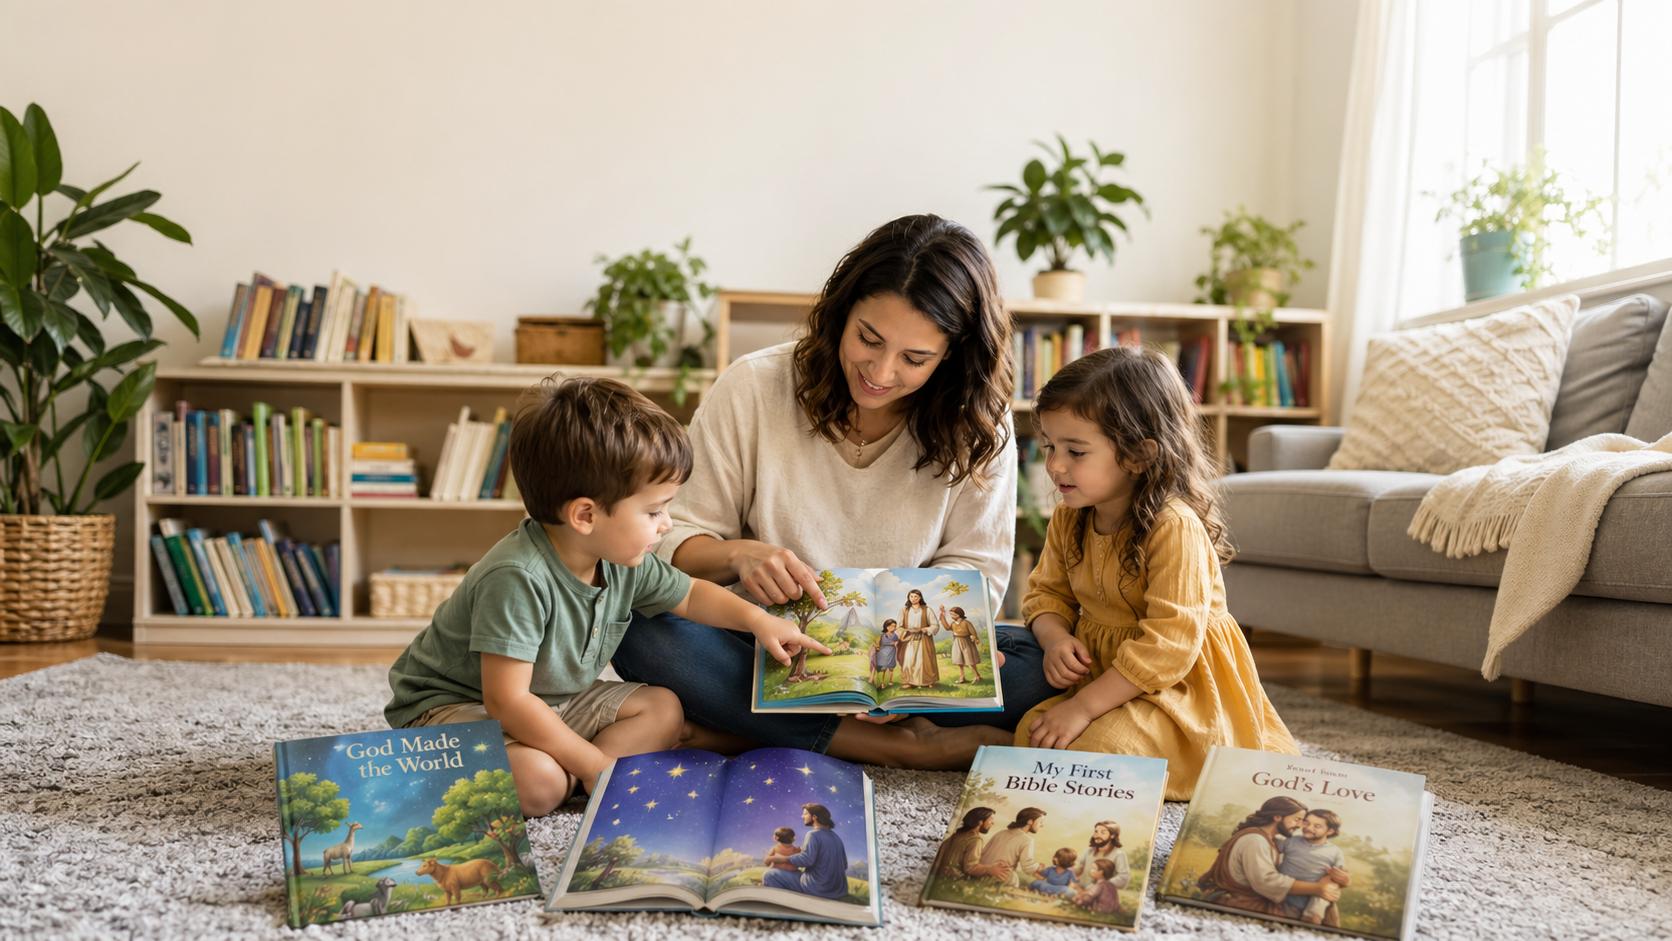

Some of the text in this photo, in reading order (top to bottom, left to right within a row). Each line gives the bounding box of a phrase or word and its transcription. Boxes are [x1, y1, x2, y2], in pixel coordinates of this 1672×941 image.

[346, 733, 461, 760] God Made
[359, 751, 464, 778] the World
[1033, 761, 1113, 780] My First
[1005, 775, 1135, 800] Bible Stories
[1252, 771, 1376, 802] God’s Love
